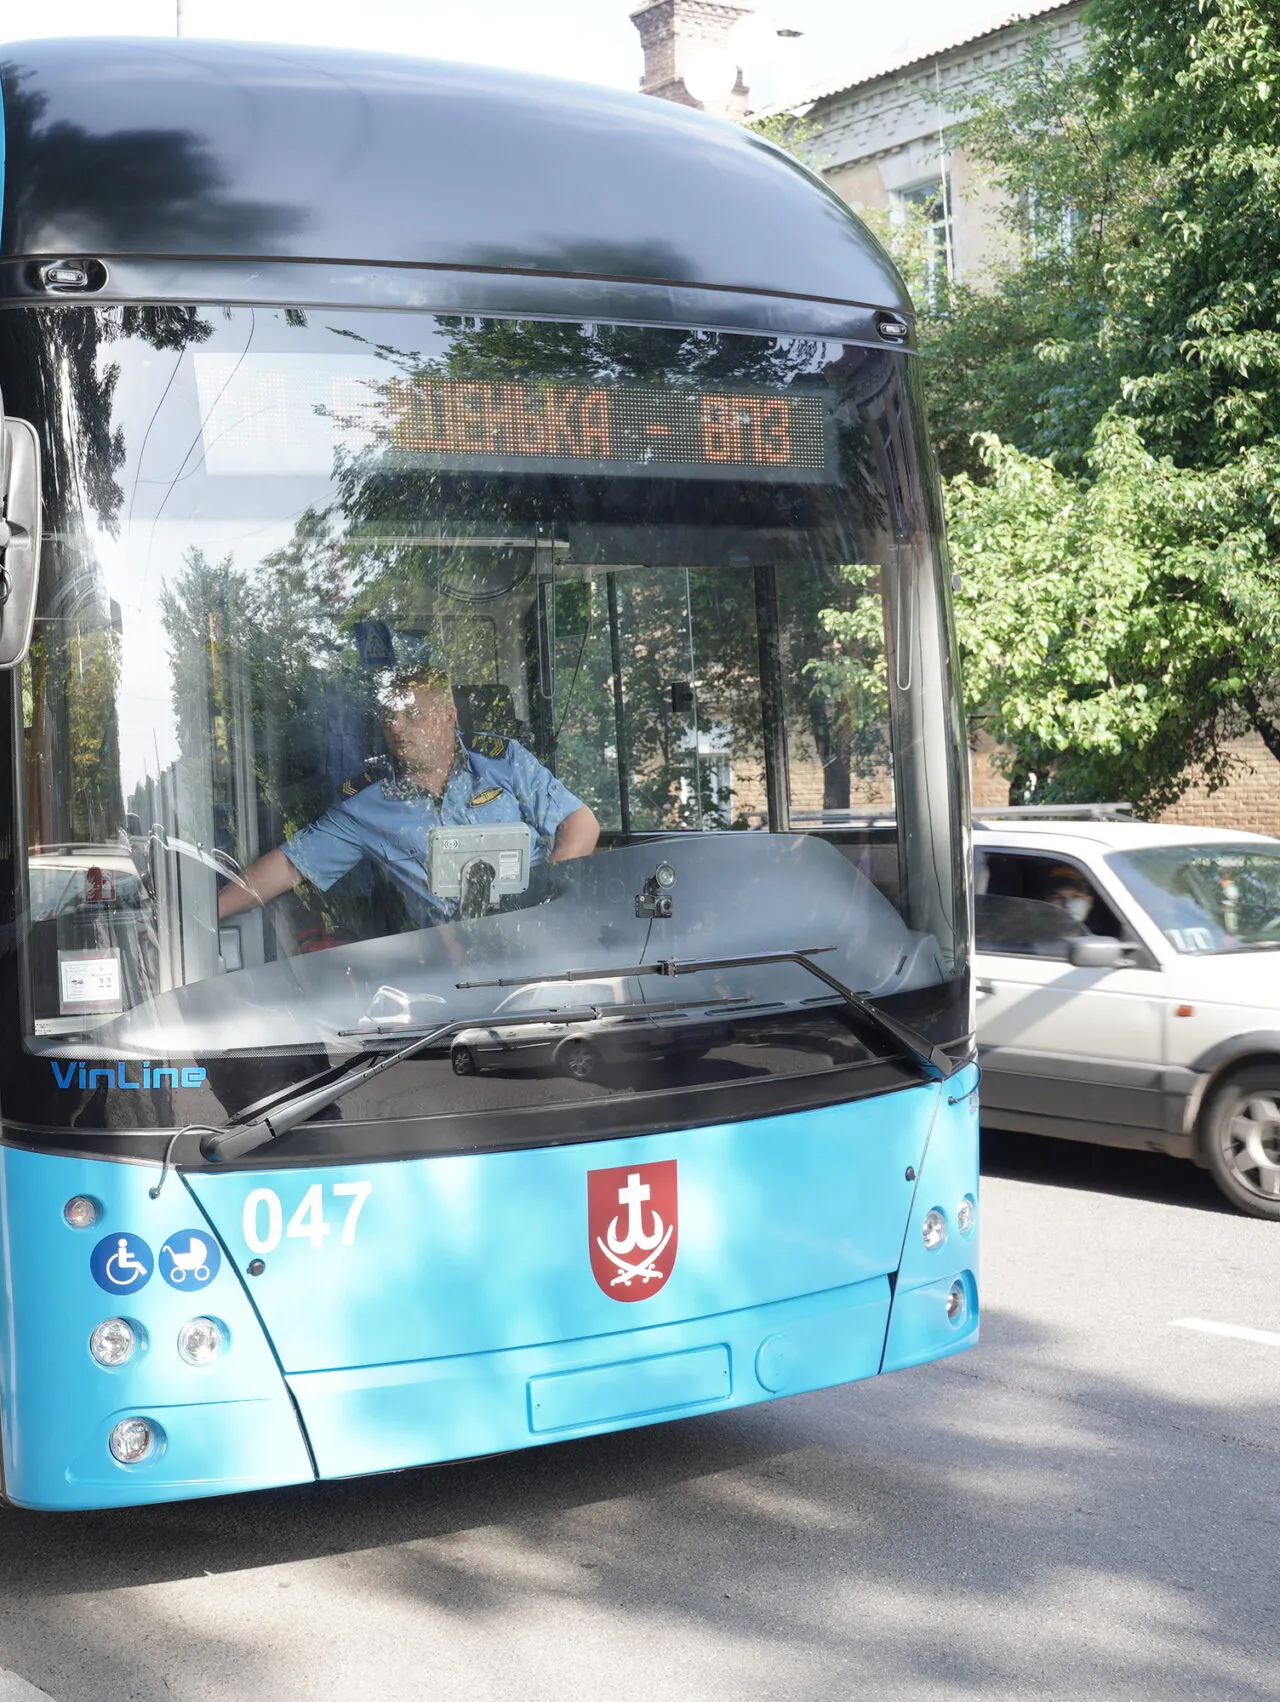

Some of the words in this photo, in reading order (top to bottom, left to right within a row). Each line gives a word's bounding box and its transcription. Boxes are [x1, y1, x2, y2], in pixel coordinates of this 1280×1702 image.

[703, 396, 790, 462] ВПЗ
[50, 1061, 207, 1089] VinLine
[242, 1180, 373, 1254] 047
